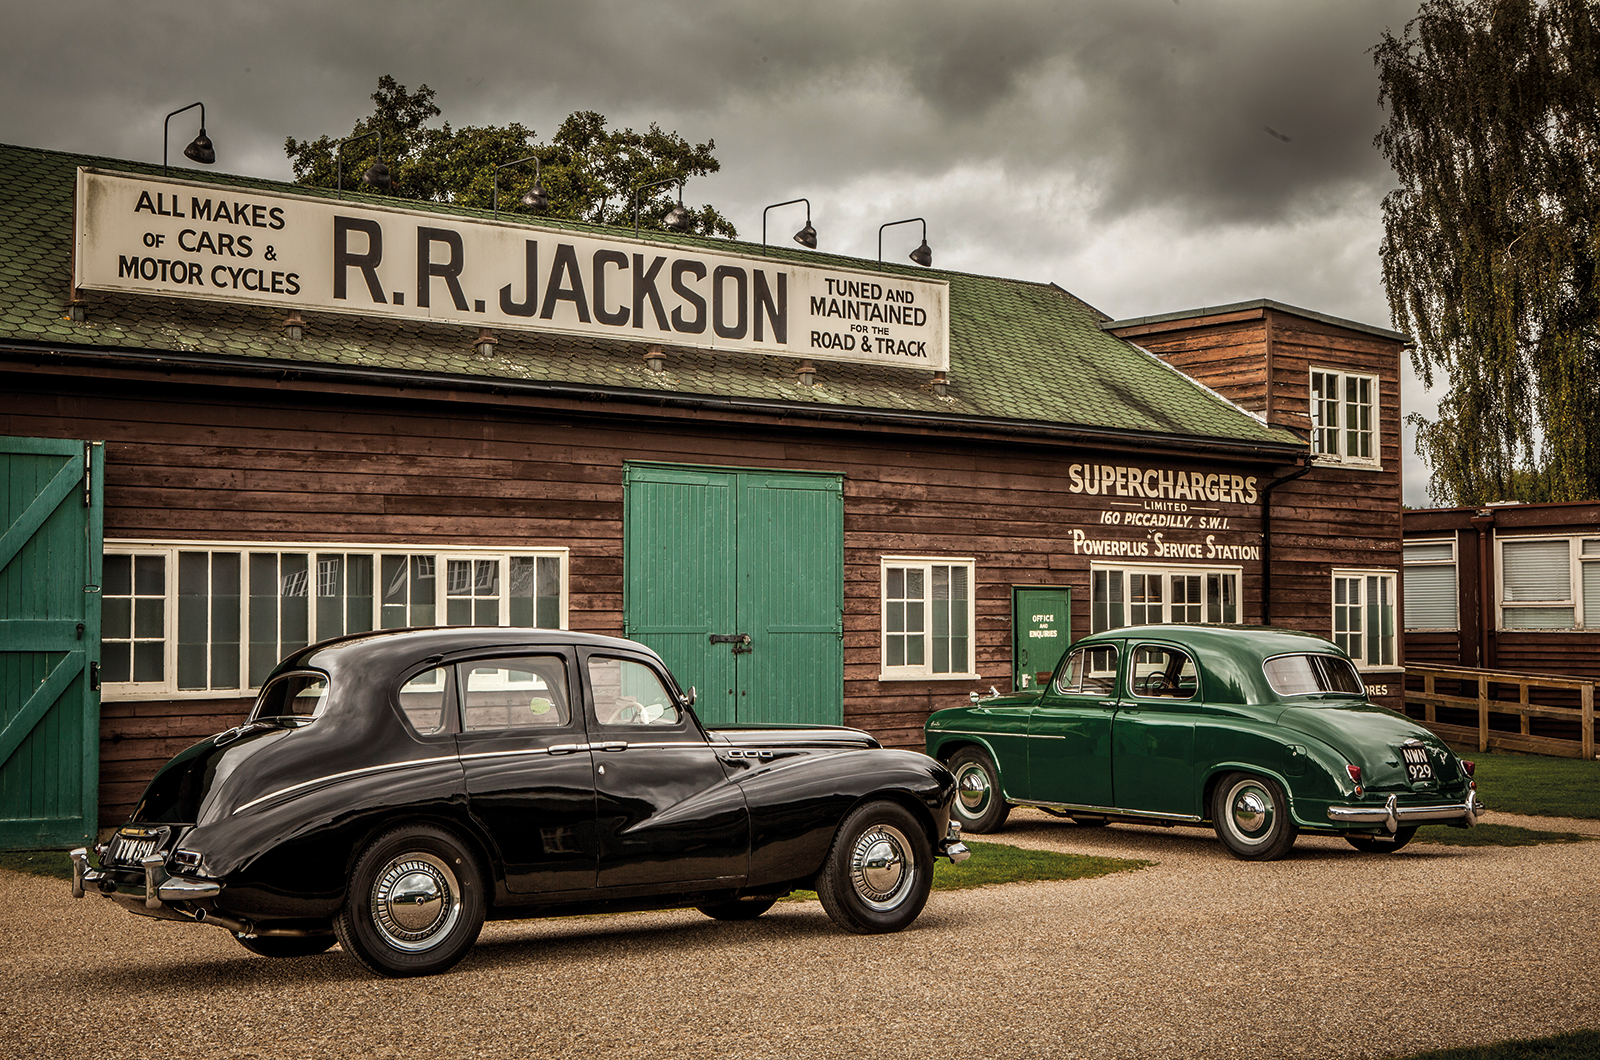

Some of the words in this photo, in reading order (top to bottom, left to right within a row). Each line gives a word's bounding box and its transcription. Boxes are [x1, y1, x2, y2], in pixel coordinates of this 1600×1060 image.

[134, 190, 185, 219] ALL
[191, 196, 286, 230] MAKES
[143, 232, 165, 249] OF
[178, 229, 253, 259] CARS
[264, 244, 278, 262] &
[118, 254, 203, 286] MOTOR
[211, 265, 300, 296] CYCLES
[499, 239, 788, 345] JACKSON
[824, 277, 883, 301] TUNED
[885, 288, 915, 304] AND
[810, 296, 927, 327] MAINTAINED
[850, 324, 869, 333] FOR
[871, 326, 889, 336] THE
[810, 331, 855, 351] ROAD
[860, 335, 873, 353] &
[875, 338, 927, 358] TRACK
[1068, 463, 1258, 504] SUPERCHARGERS
[1100, 511, 1120, 525] 160
[1144, 501, 1188, 512] LIMITED
[1154, 532, 1202, 559] SERVICE
[1206, 535, 1260, 560] STATION
[1032, 614, 1054, 622] OFFICE
[1029, 630, 1058, 639] ENQUIRIES
[1409, 764, 1431, 779] 929
